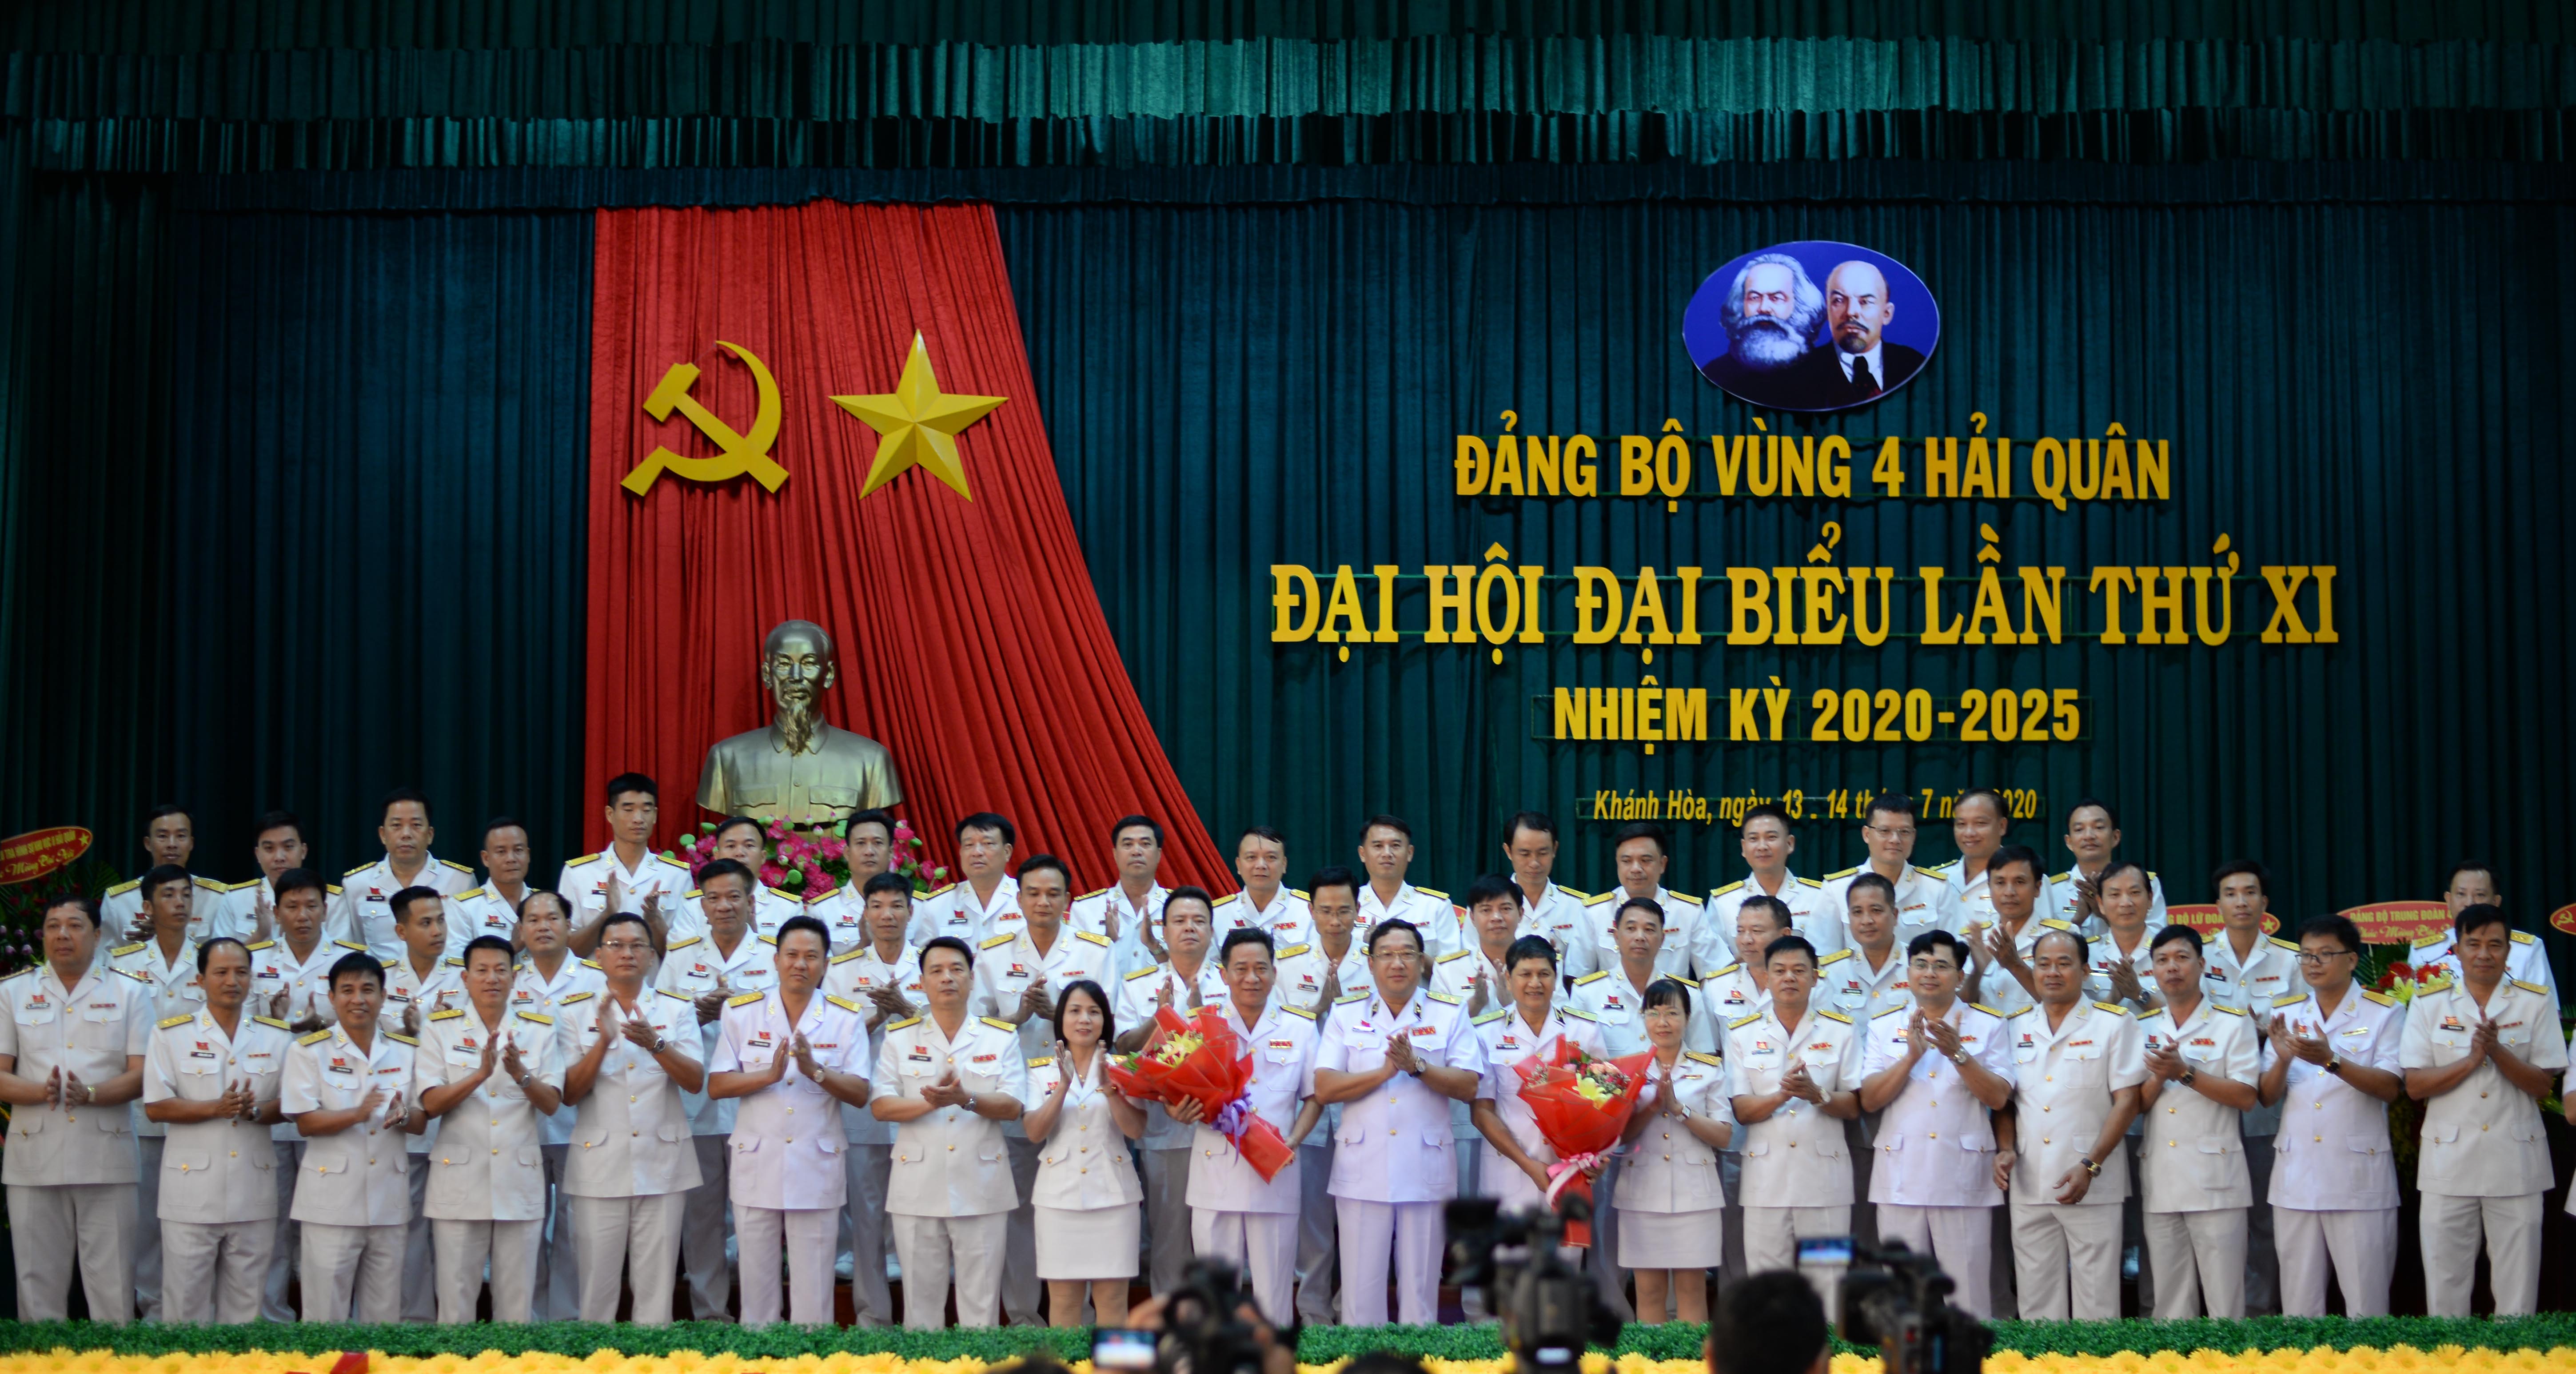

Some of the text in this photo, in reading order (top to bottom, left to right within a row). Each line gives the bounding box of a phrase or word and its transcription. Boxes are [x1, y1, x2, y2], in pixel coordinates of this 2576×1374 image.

[1454, 410, 2169, 513] ĐẢNG BỘ VÙNG 4 HẢI QUÂN
[1271, 521, 2338, 665] ĐẠI HỘI ĐẠI BIỂU LẦN THỨ XI
[1554, 675, 2080, 755] NHIỆM KỲ 2020-2025
[1593, 789, 1659, 820] Khánh
[1667, 789, 1712, 825] Hòa,
[1782, 789, 1803, 820] 13
[1827, 789, 1848, 819] 14
[1922, 788, 1934, 819] 7
